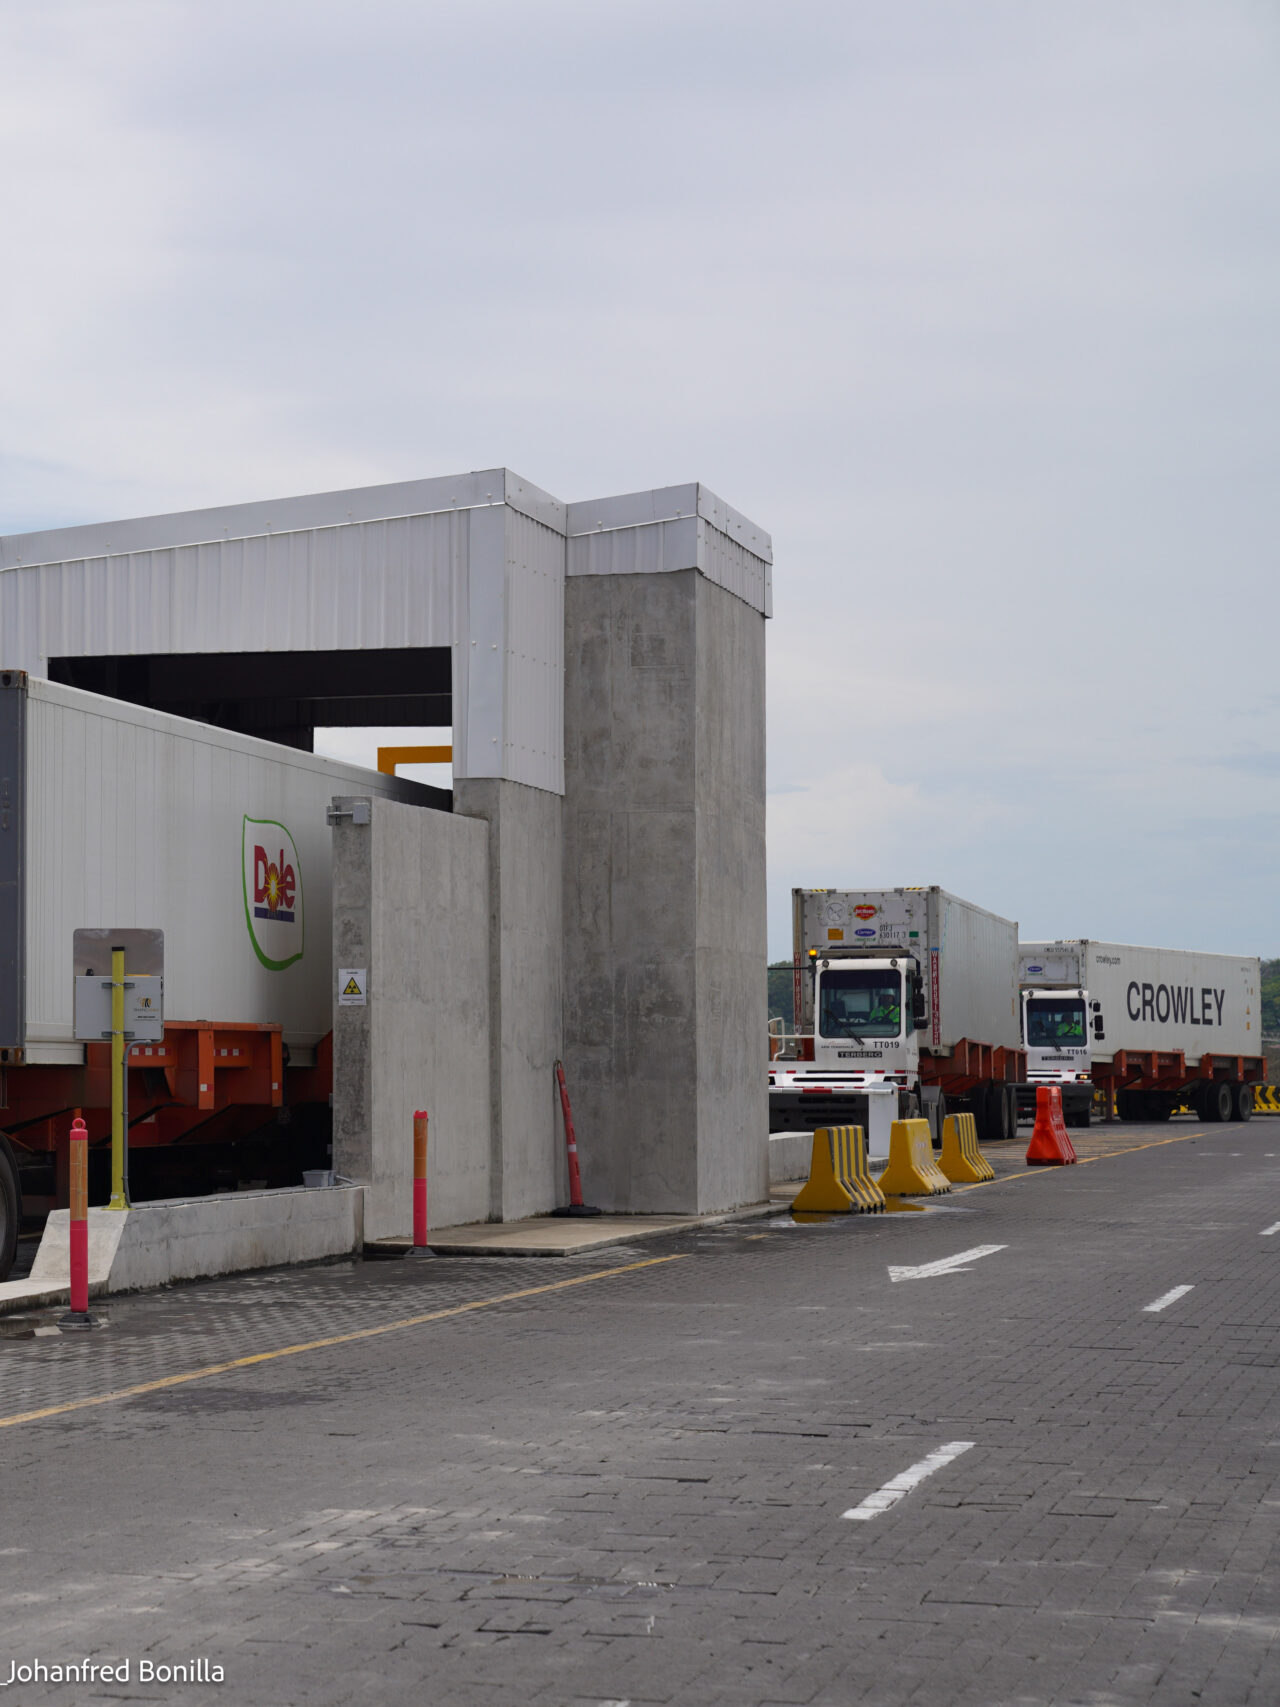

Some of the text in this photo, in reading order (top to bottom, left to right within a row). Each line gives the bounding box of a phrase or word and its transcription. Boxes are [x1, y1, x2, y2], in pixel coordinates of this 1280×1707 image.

[254, 845, 296, 912] Dole
[1126, 981, 1226, 1026] CROWLEY
[873, 1041, 900, 1049] TT019
